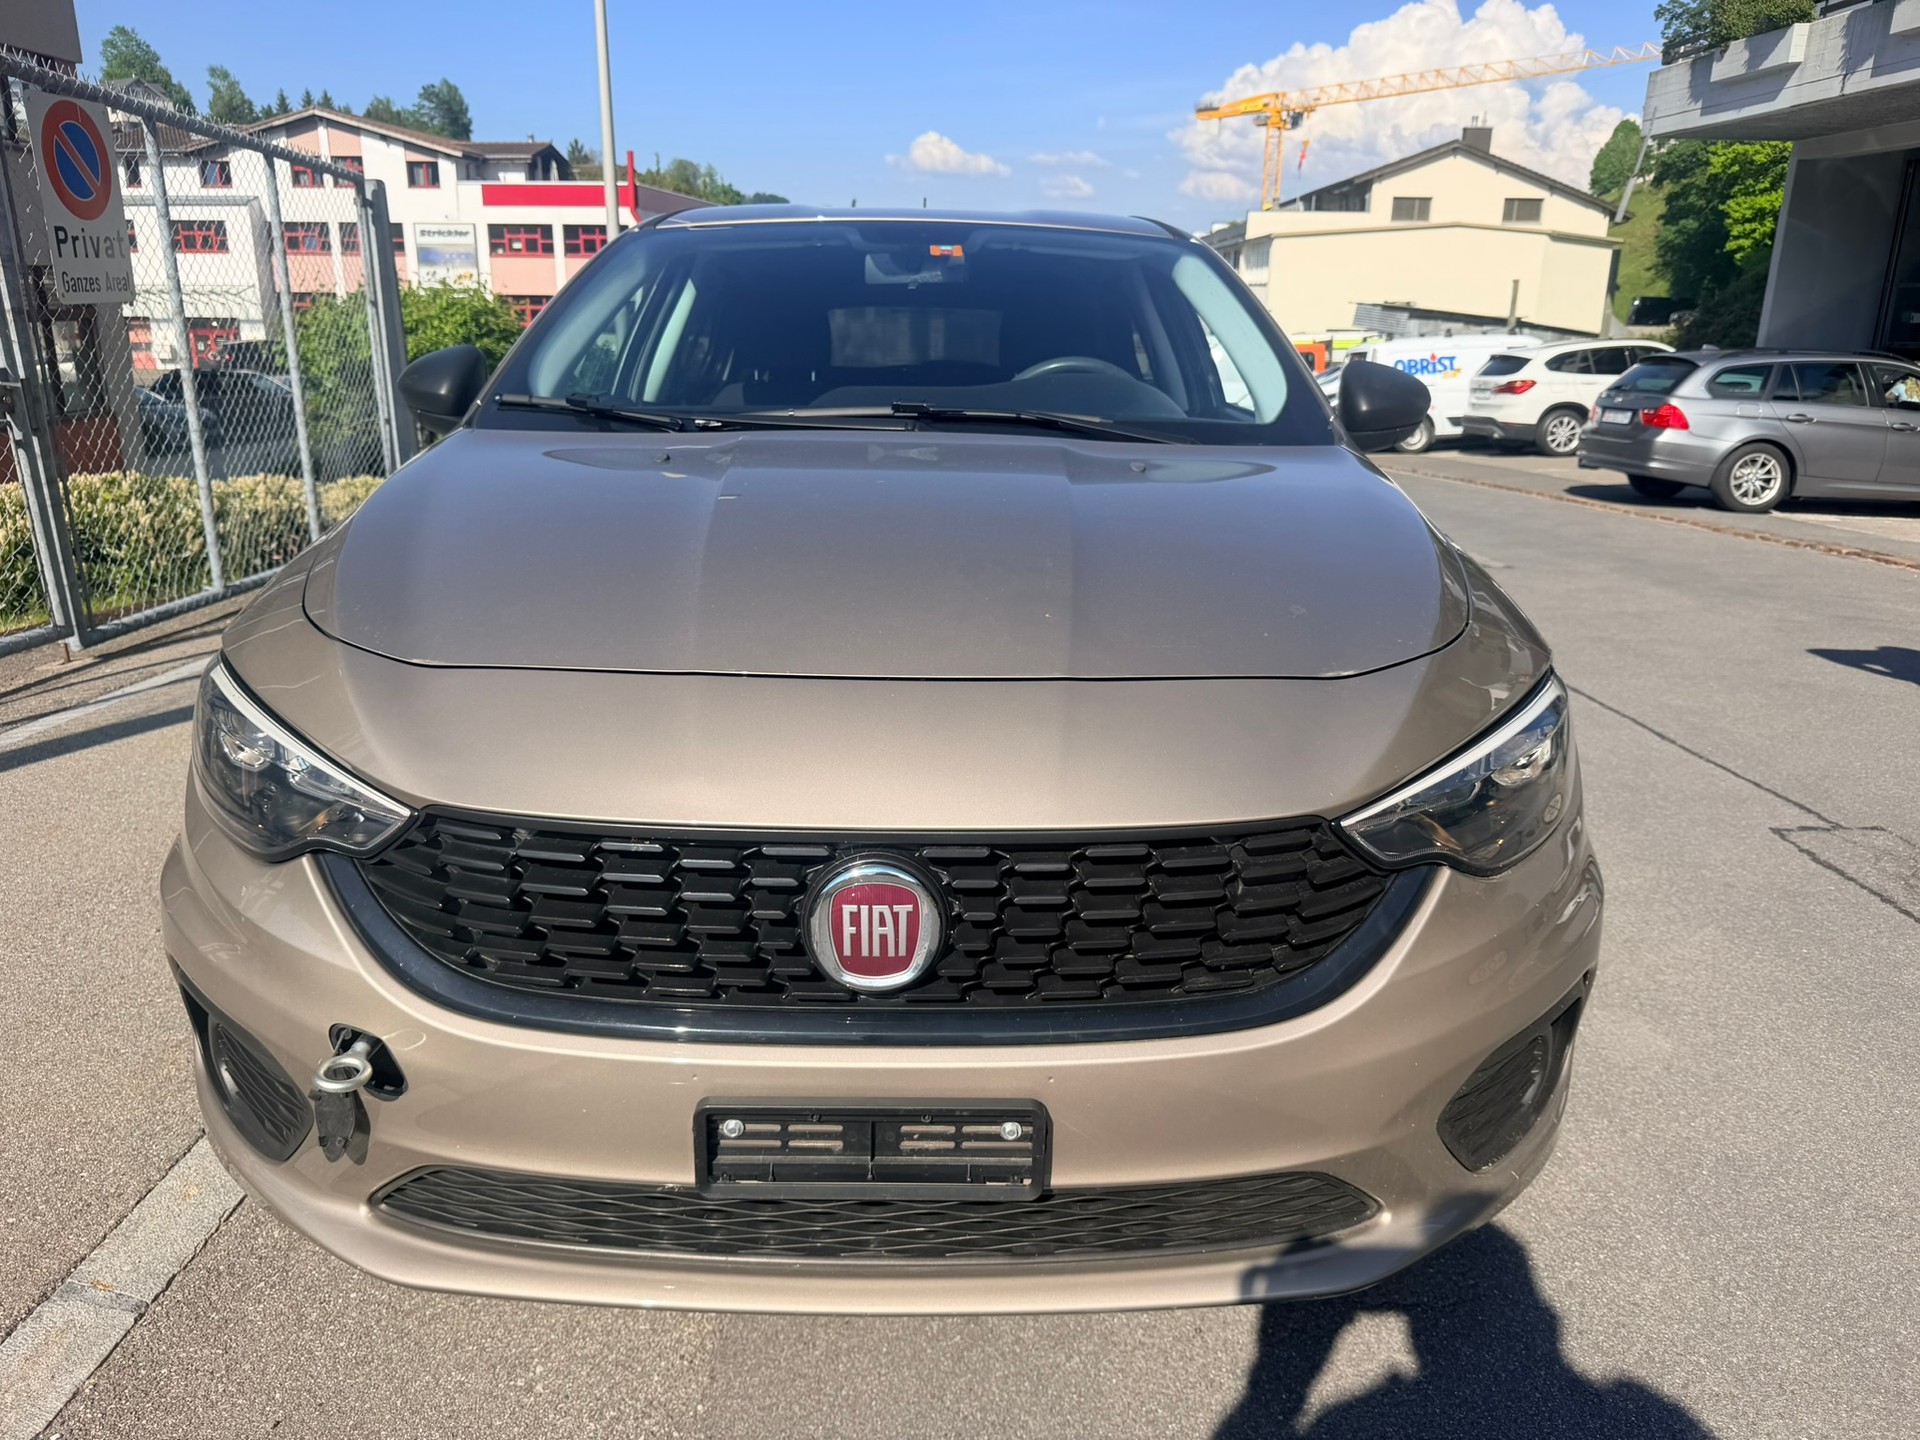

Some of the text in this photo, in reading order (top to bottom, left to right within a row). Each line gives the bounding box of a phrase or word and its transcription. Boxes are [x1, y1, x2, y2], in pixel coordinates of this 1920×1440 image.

[54, 225, 127, 259] Privat
[61, 271, 130, 294] Ganzes Areal
[842, 904, 914, 957] FIAT
